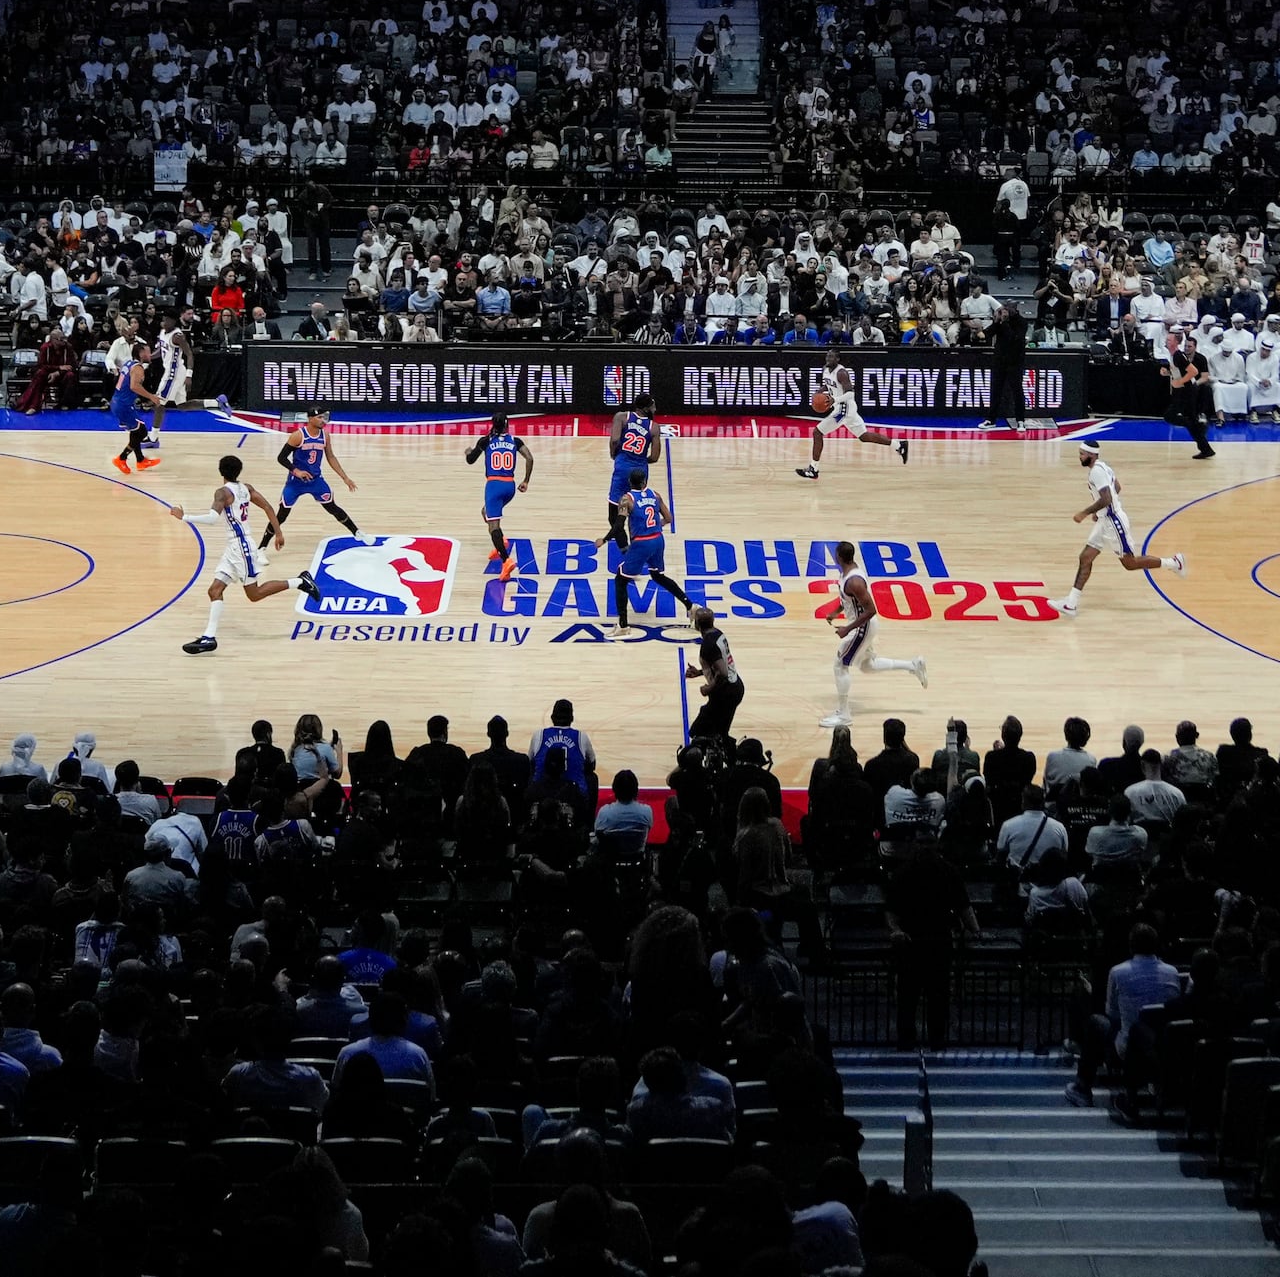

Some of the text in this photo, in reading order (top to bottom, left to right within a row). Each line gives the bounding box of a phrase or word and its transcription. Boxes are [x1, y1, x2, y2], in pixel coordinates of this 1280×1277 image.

[263, 361, 573, 404] REWARDS FOR EVERY FAN
[683, 366, 803, 406] REWARDS
[862, 367, 940, 407] EVERY
[945, 368, 991, 408] FAN
[622, 432, 647, 455] 23
[307, 450, 317, 464] 3
[490, 450, 514, 471] 00
[644, 506, 656, 528] 2
[684, 539, 950, 578] DHABI
[319, 596, 389, 613] NBA
[481, 577, 1061, 622] GAMES 2025
[290, 620, 532, 646] Presented by
